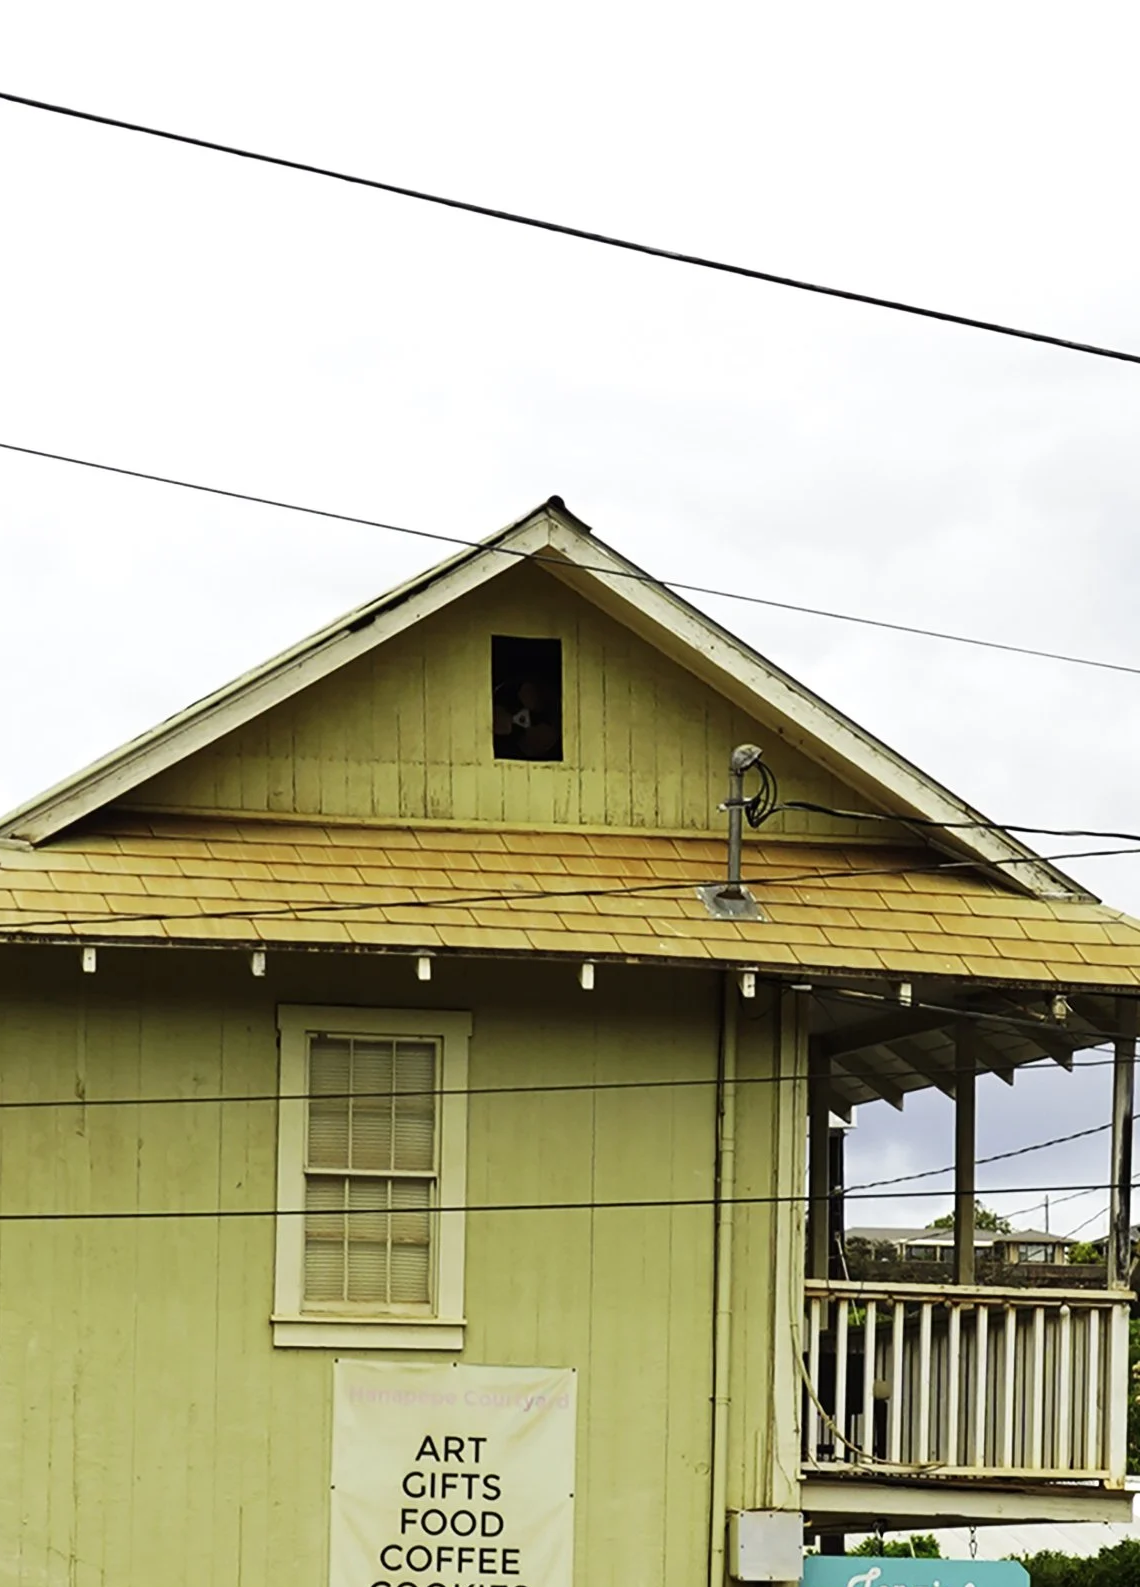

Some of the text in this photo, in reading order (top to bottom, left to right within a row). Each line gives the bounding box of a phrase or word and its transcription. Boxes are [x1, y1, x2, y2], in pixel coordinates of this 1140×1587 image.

[463, 1389, 570, 1412] Courtyad
[414, 1435, 488, 1464] ART
[402, 1471, 502, 1501] GIFTS
[400, 1508, 504, 1538] FOOD
[379, 1544, 520, 1575] COFFEE
